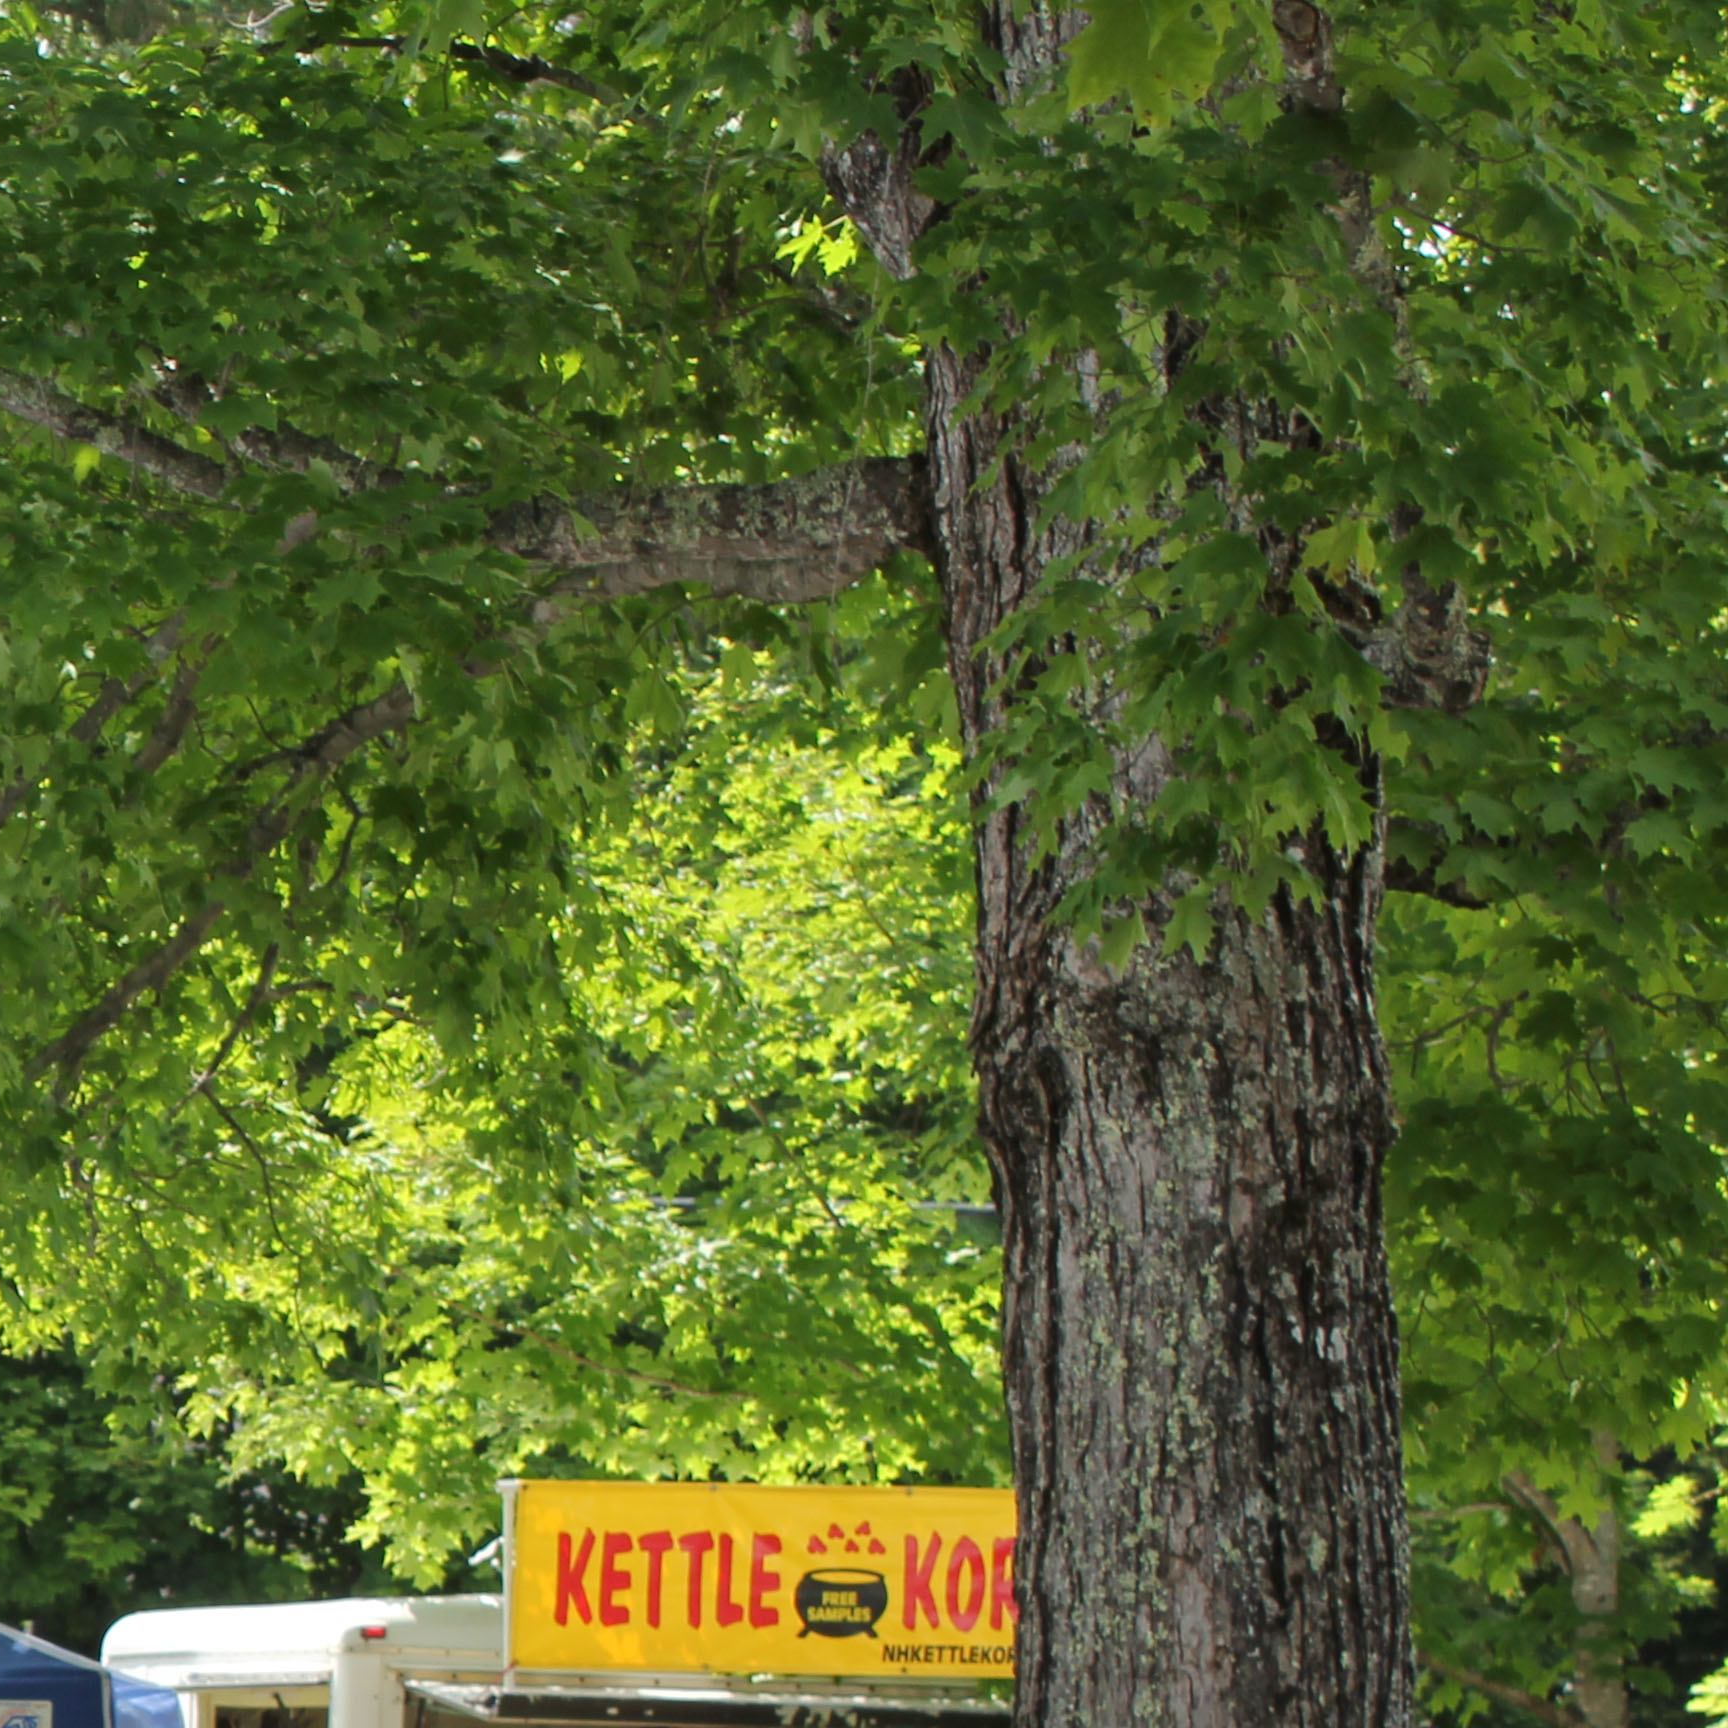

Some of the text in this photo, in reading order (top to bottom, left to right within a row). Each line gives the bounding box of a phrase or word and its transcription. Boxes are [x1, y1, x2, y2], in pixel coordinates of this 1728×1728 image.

[553, 1526, 783, 1630] KETTLE
[821, 1590, 857, 1607] FREE
[806, 1605, 872, 1623] SAMPLES
